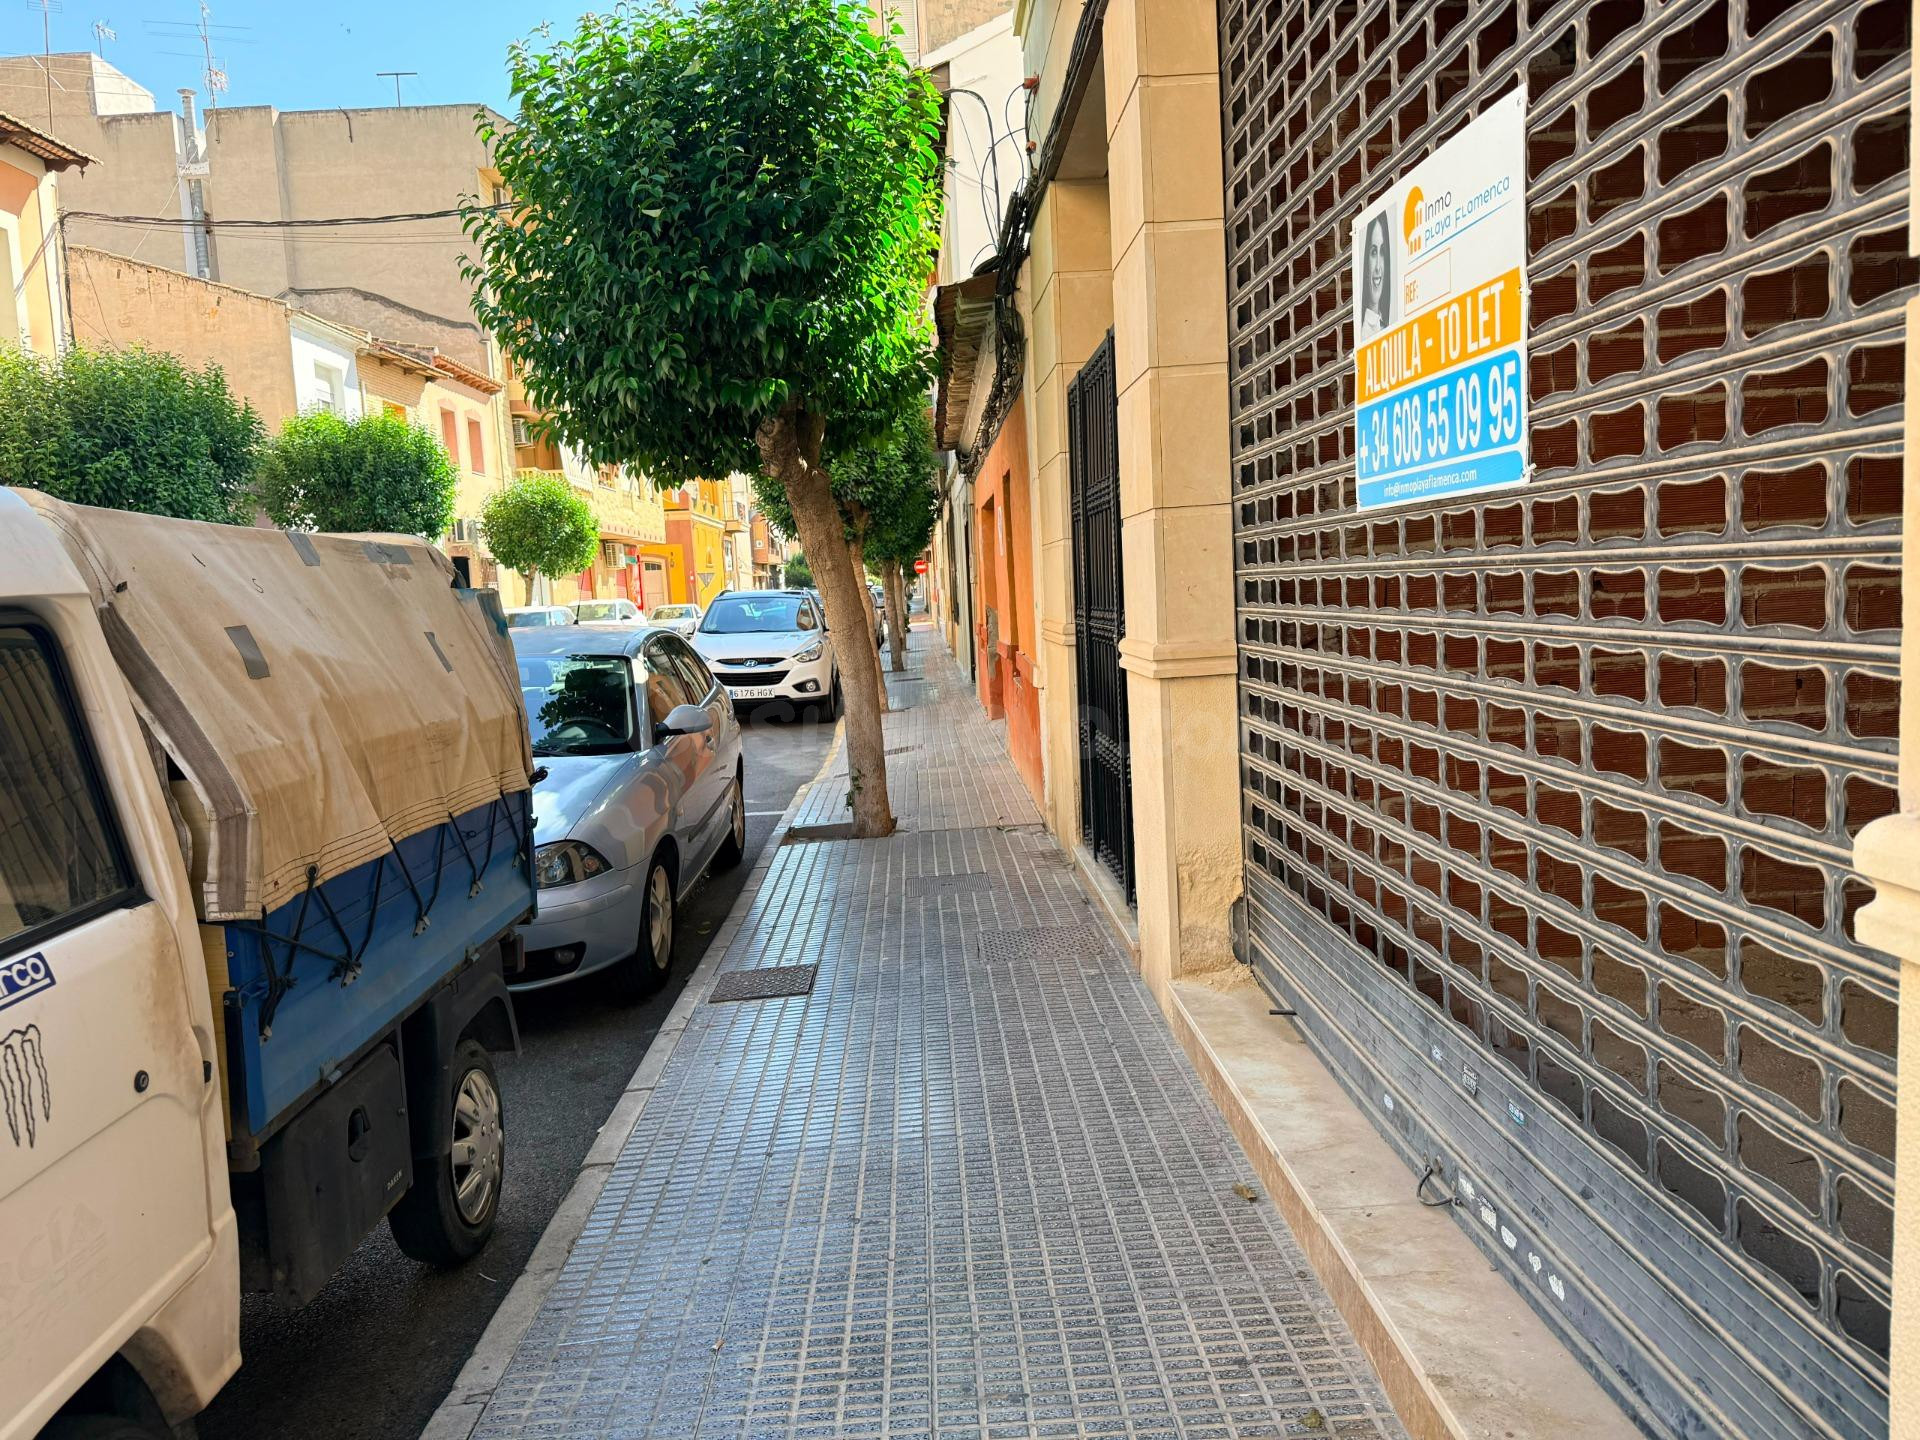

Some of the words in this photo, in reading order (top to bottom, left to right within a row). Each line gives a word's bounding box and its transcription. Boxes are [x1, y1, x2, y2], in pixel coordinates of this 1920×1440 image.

[1424, 191, 1452, 222] Inmo
[1404, 280, 1419, 305] REF:
[1365, 323, 1422, 397] ALQUILA
[1437, 302, 1461, 364] TO
[1466, 280, 1505, 353] LET
[1392, 394, 1422, 467] 608
[1427, 384, 1449, 458] 55
[1455, 372, 1482, 451] 09
[1488, 360, 1517, 444] 95
[1383, 468, 1478, 497] info@inmoplayaflamenca.com
[733, 689, 755, 698] 6176
[757, 688, 774, 697] HGX
[0, 957, 46, 998] rco
